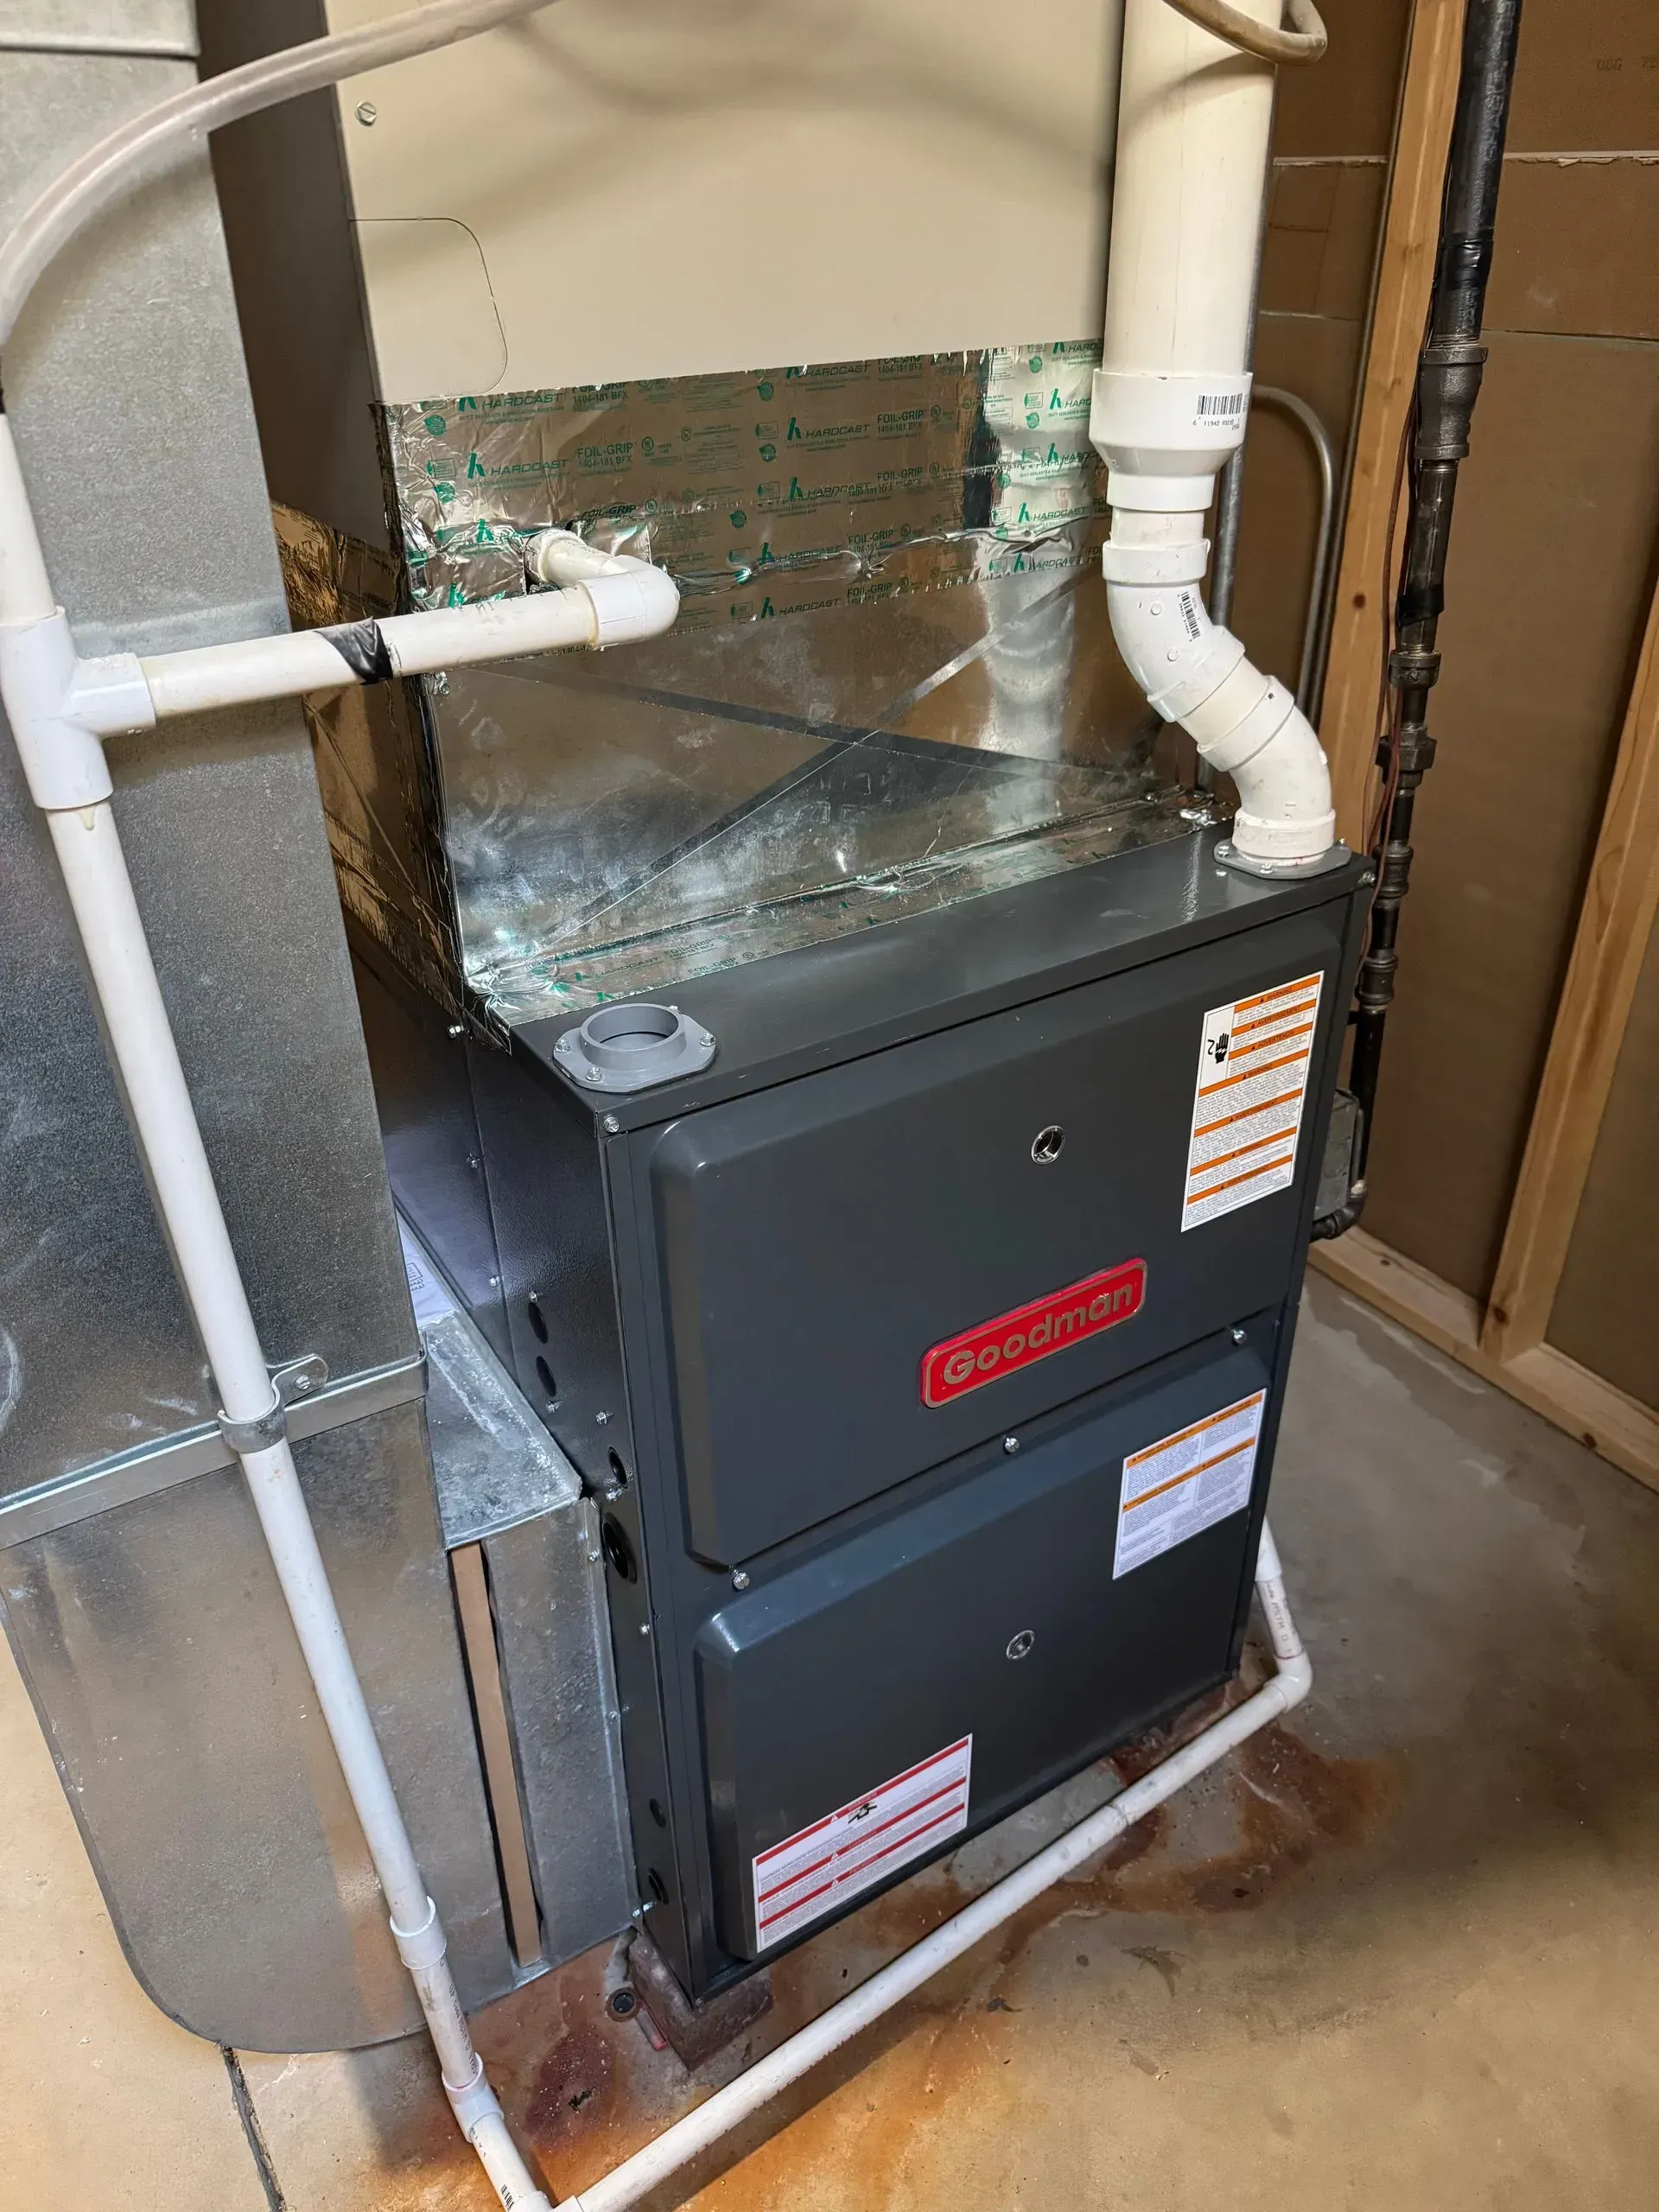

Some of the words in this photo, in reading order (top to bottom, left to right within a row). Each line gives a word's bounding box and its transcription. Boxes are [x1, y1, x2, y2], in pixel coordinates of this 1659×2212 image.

[805, 364, 871, 378] HARDCAST
[481, 393, 563, 410] HARDCAST
[611, 391, 628, 400] BFX
[877, 410, 924, 423] FOIL-GRIP
[805, 424, 871, 438] HARDCAST
[577, 442, 633, 459] FOIL-GRIP
[615, 454, 632, 465] BFX
[490, 459, 569, 476] HARDCAST
[877, 467, 923, 481] FOIL-GRIP
[582, 504, 636, 518] FOIL-GRIP
[1033, 506, 1086, 521] HARDCAST
[849, 529, 893, 545] FOIL-GRIP
[848, 582, 892, 597] FOIL-GRIP
[779, 598, 842, 615] HARDCAST
[1267, 988, 1293, 1001] WARNING
[1257, 1005, 1300, 1027] AVERTISSEMENT
[1248, 1063, 1273, 1077] WARNING
[1235, 1099, 1278, 1121] AVERTISSEMENT
[942, 1283, 1135, 1384] Goodman
